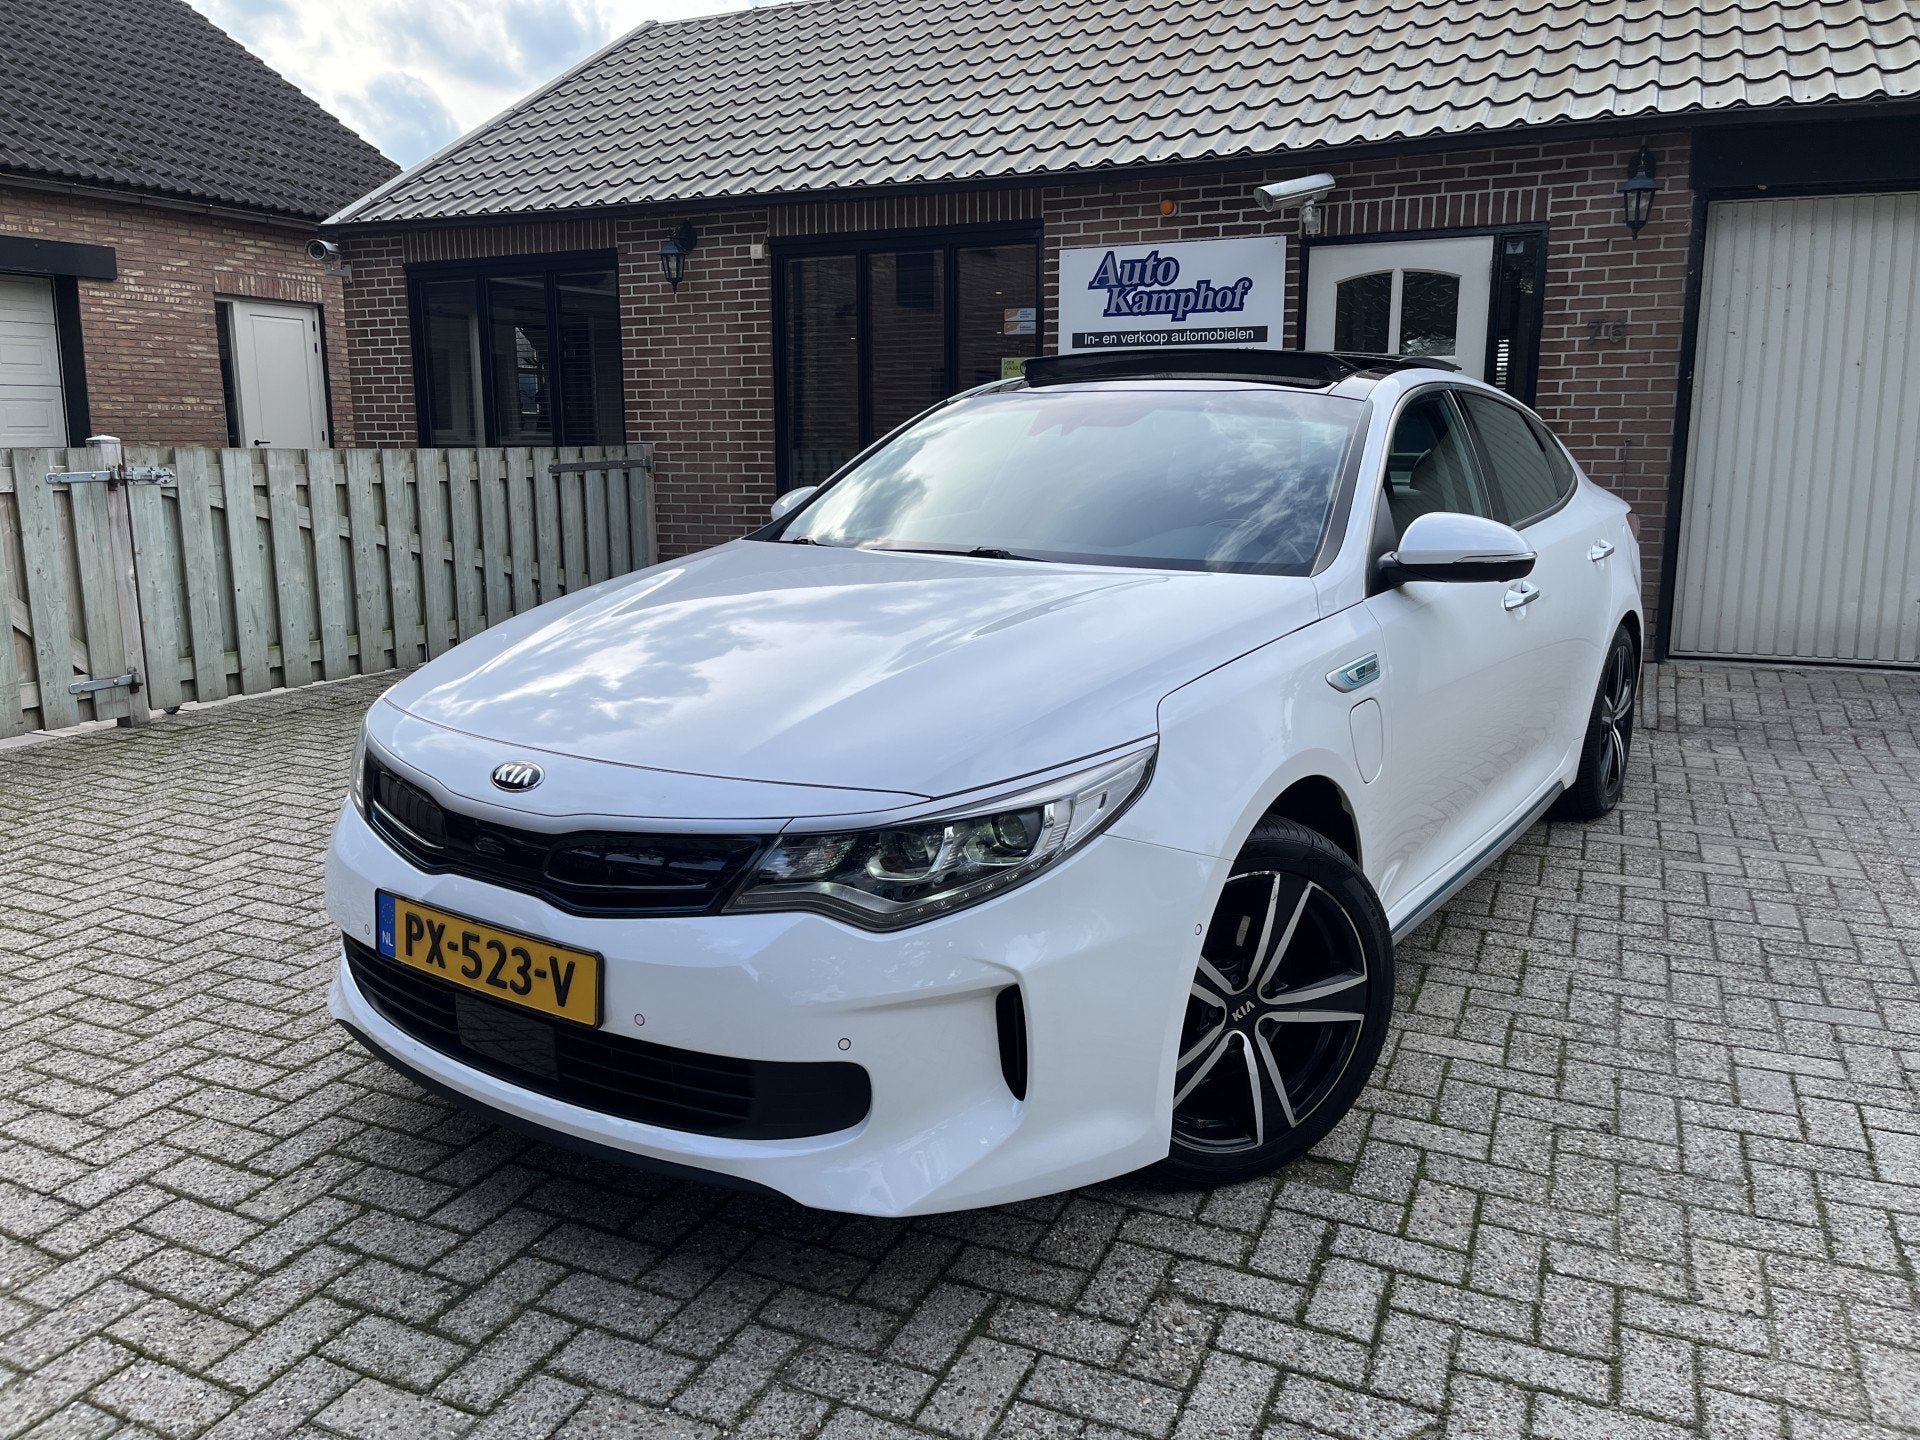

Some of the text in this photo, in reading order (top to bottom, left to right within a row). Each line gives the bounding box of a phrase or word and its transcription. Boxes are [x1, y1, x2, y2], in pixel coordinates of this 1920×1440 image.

[1088, 250, 1180, 290] Auto
[1103, 277, 1253, 322] Kamphof
[1084, 328, 1254, 345] In- en verkoop automobielen
[495, 763, 534, 787] KIA
[382, 930, 394, 947] NL
[405, 911, 576, 1008] PX-523-V
[1231, 1000, 1256, 1022] KIA
